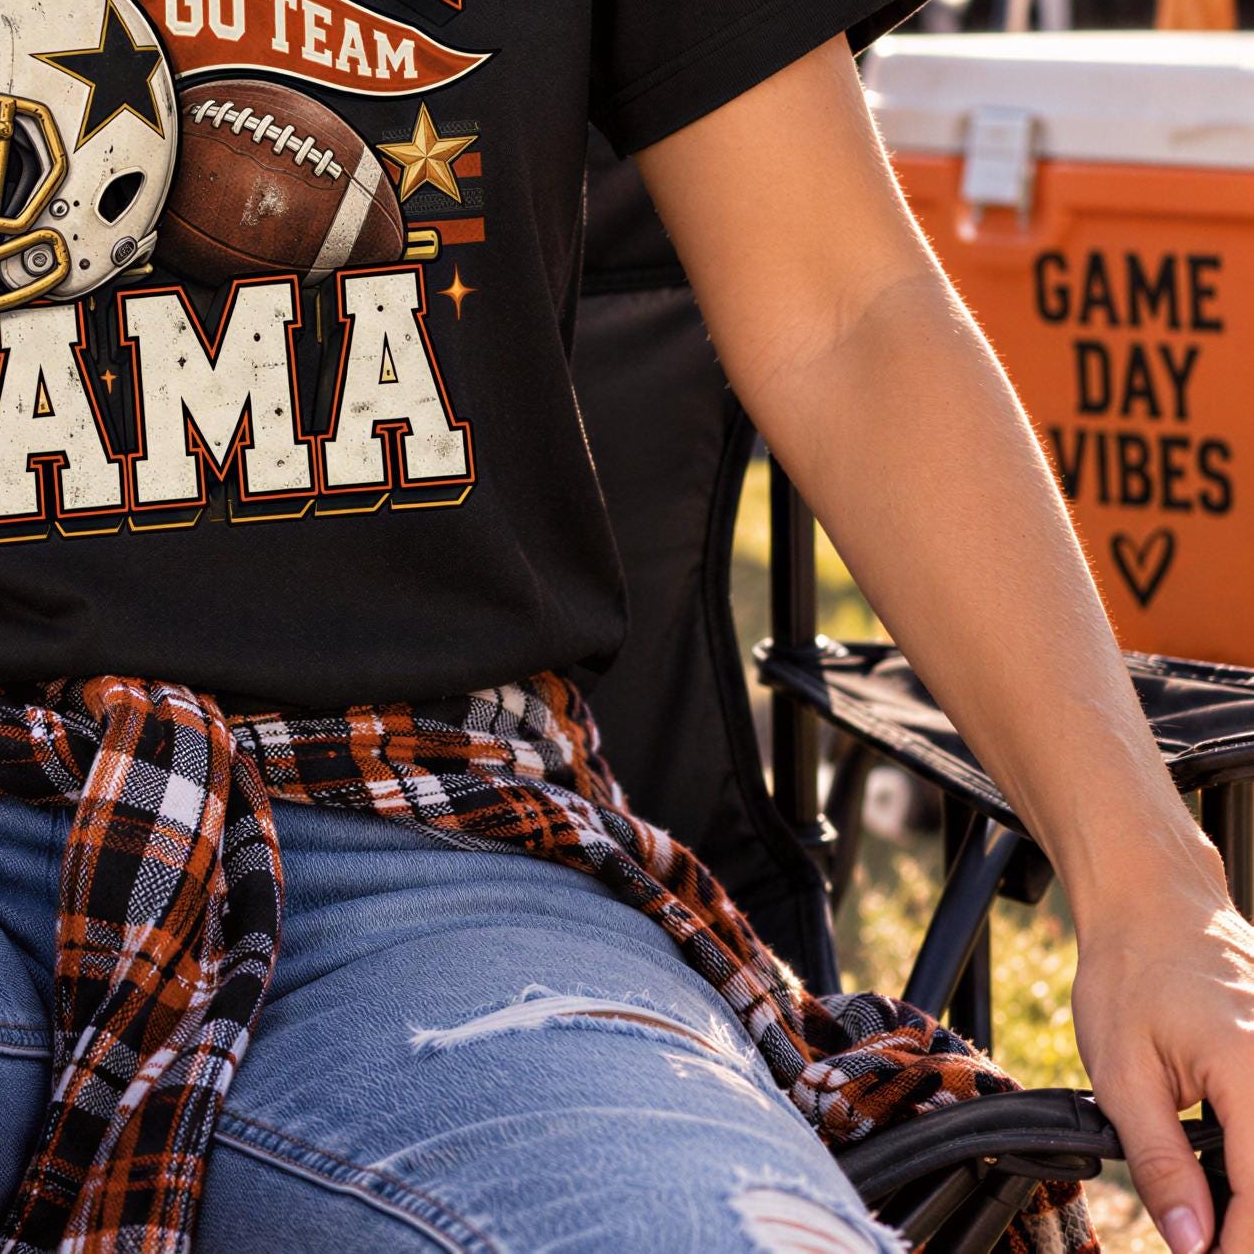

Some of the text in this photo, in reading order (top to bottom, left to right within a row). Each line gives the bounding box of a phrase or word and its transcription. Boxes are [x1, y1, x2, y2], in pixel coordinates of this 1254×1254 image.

[1033, 249, 1225, 333] GAME
[1074, 339, 1200, 422] DAY
[1049, 426, 1234, 516] VIBES
